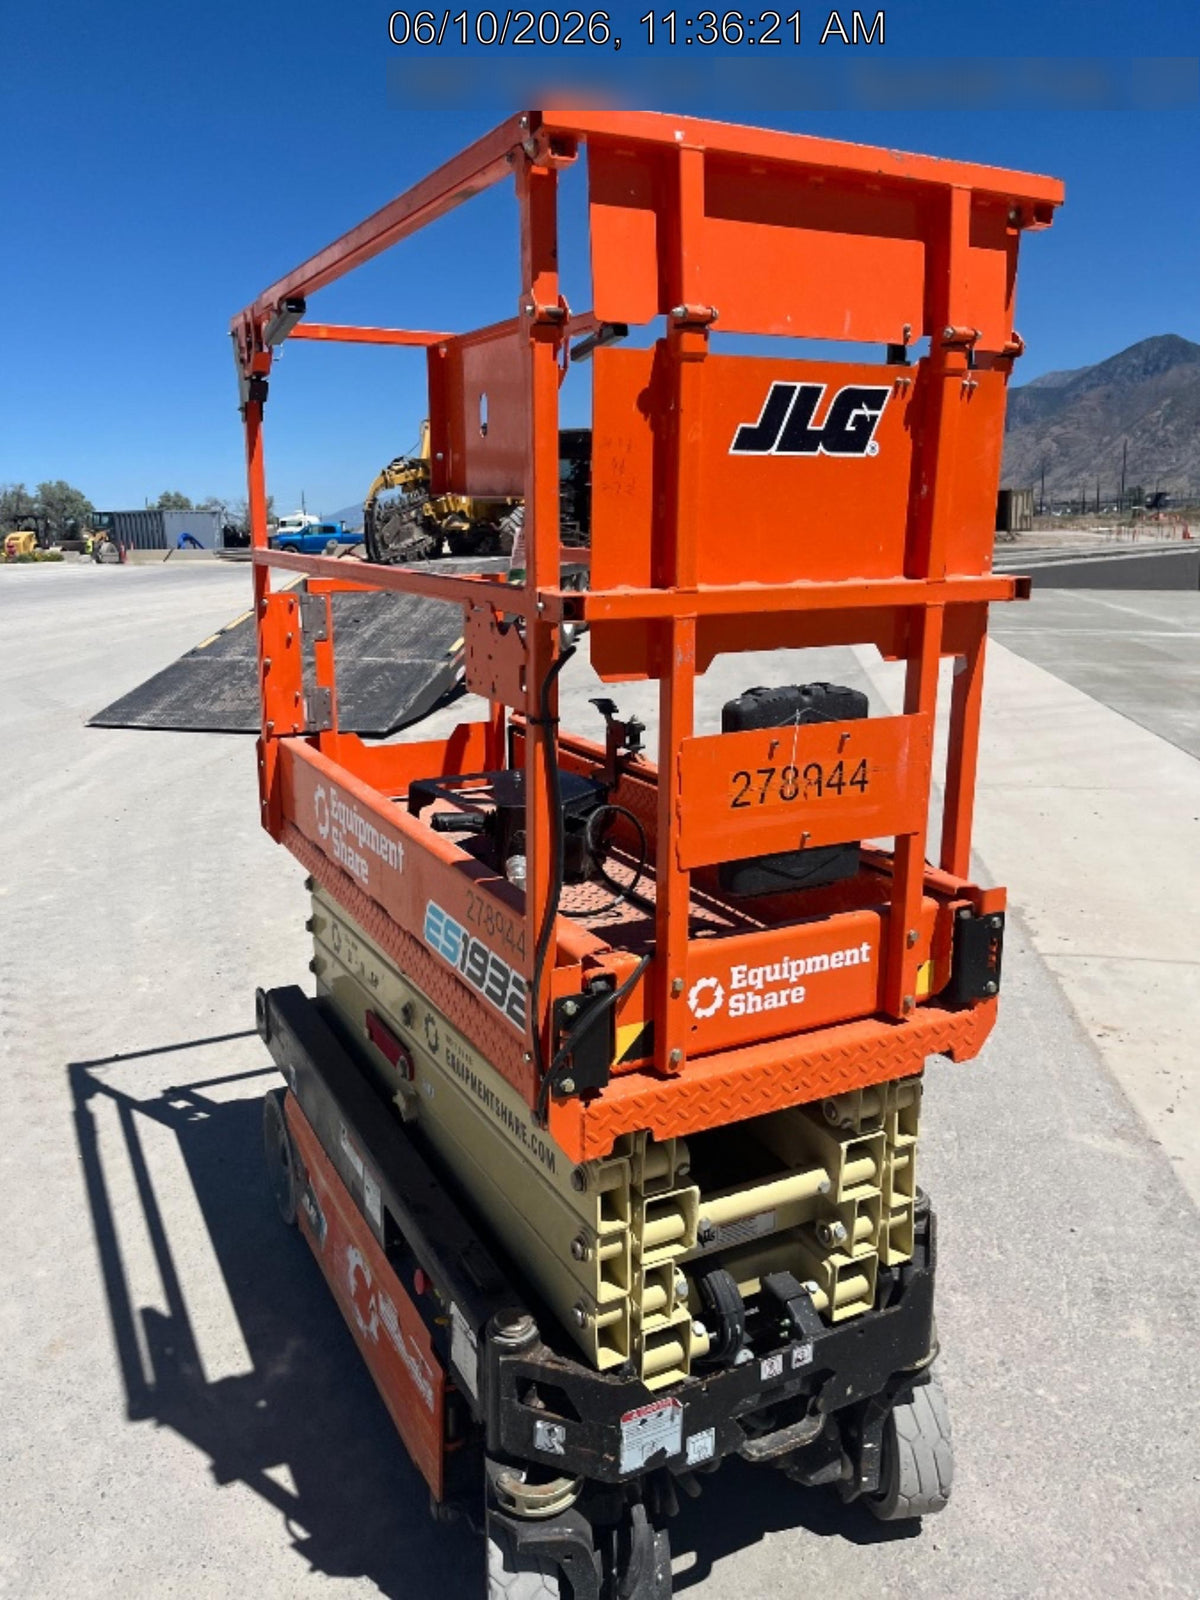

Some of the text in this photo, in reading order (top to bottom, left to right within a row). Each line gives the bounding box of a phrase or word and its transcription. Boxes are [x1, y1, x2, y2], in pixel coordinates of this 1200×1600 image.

[728, 381, 893, 457] JLG
[330, 787, 404, 875] Equipment
[332, 826, 369, 885] Share
[424, 899, 527, 1034] ES1932
[728, 985, 806, 1017] Share
[729, 942, 871, 990] Equipment
[445, 1047, 557, 1175] EQUIPMENTSHARE.COM
